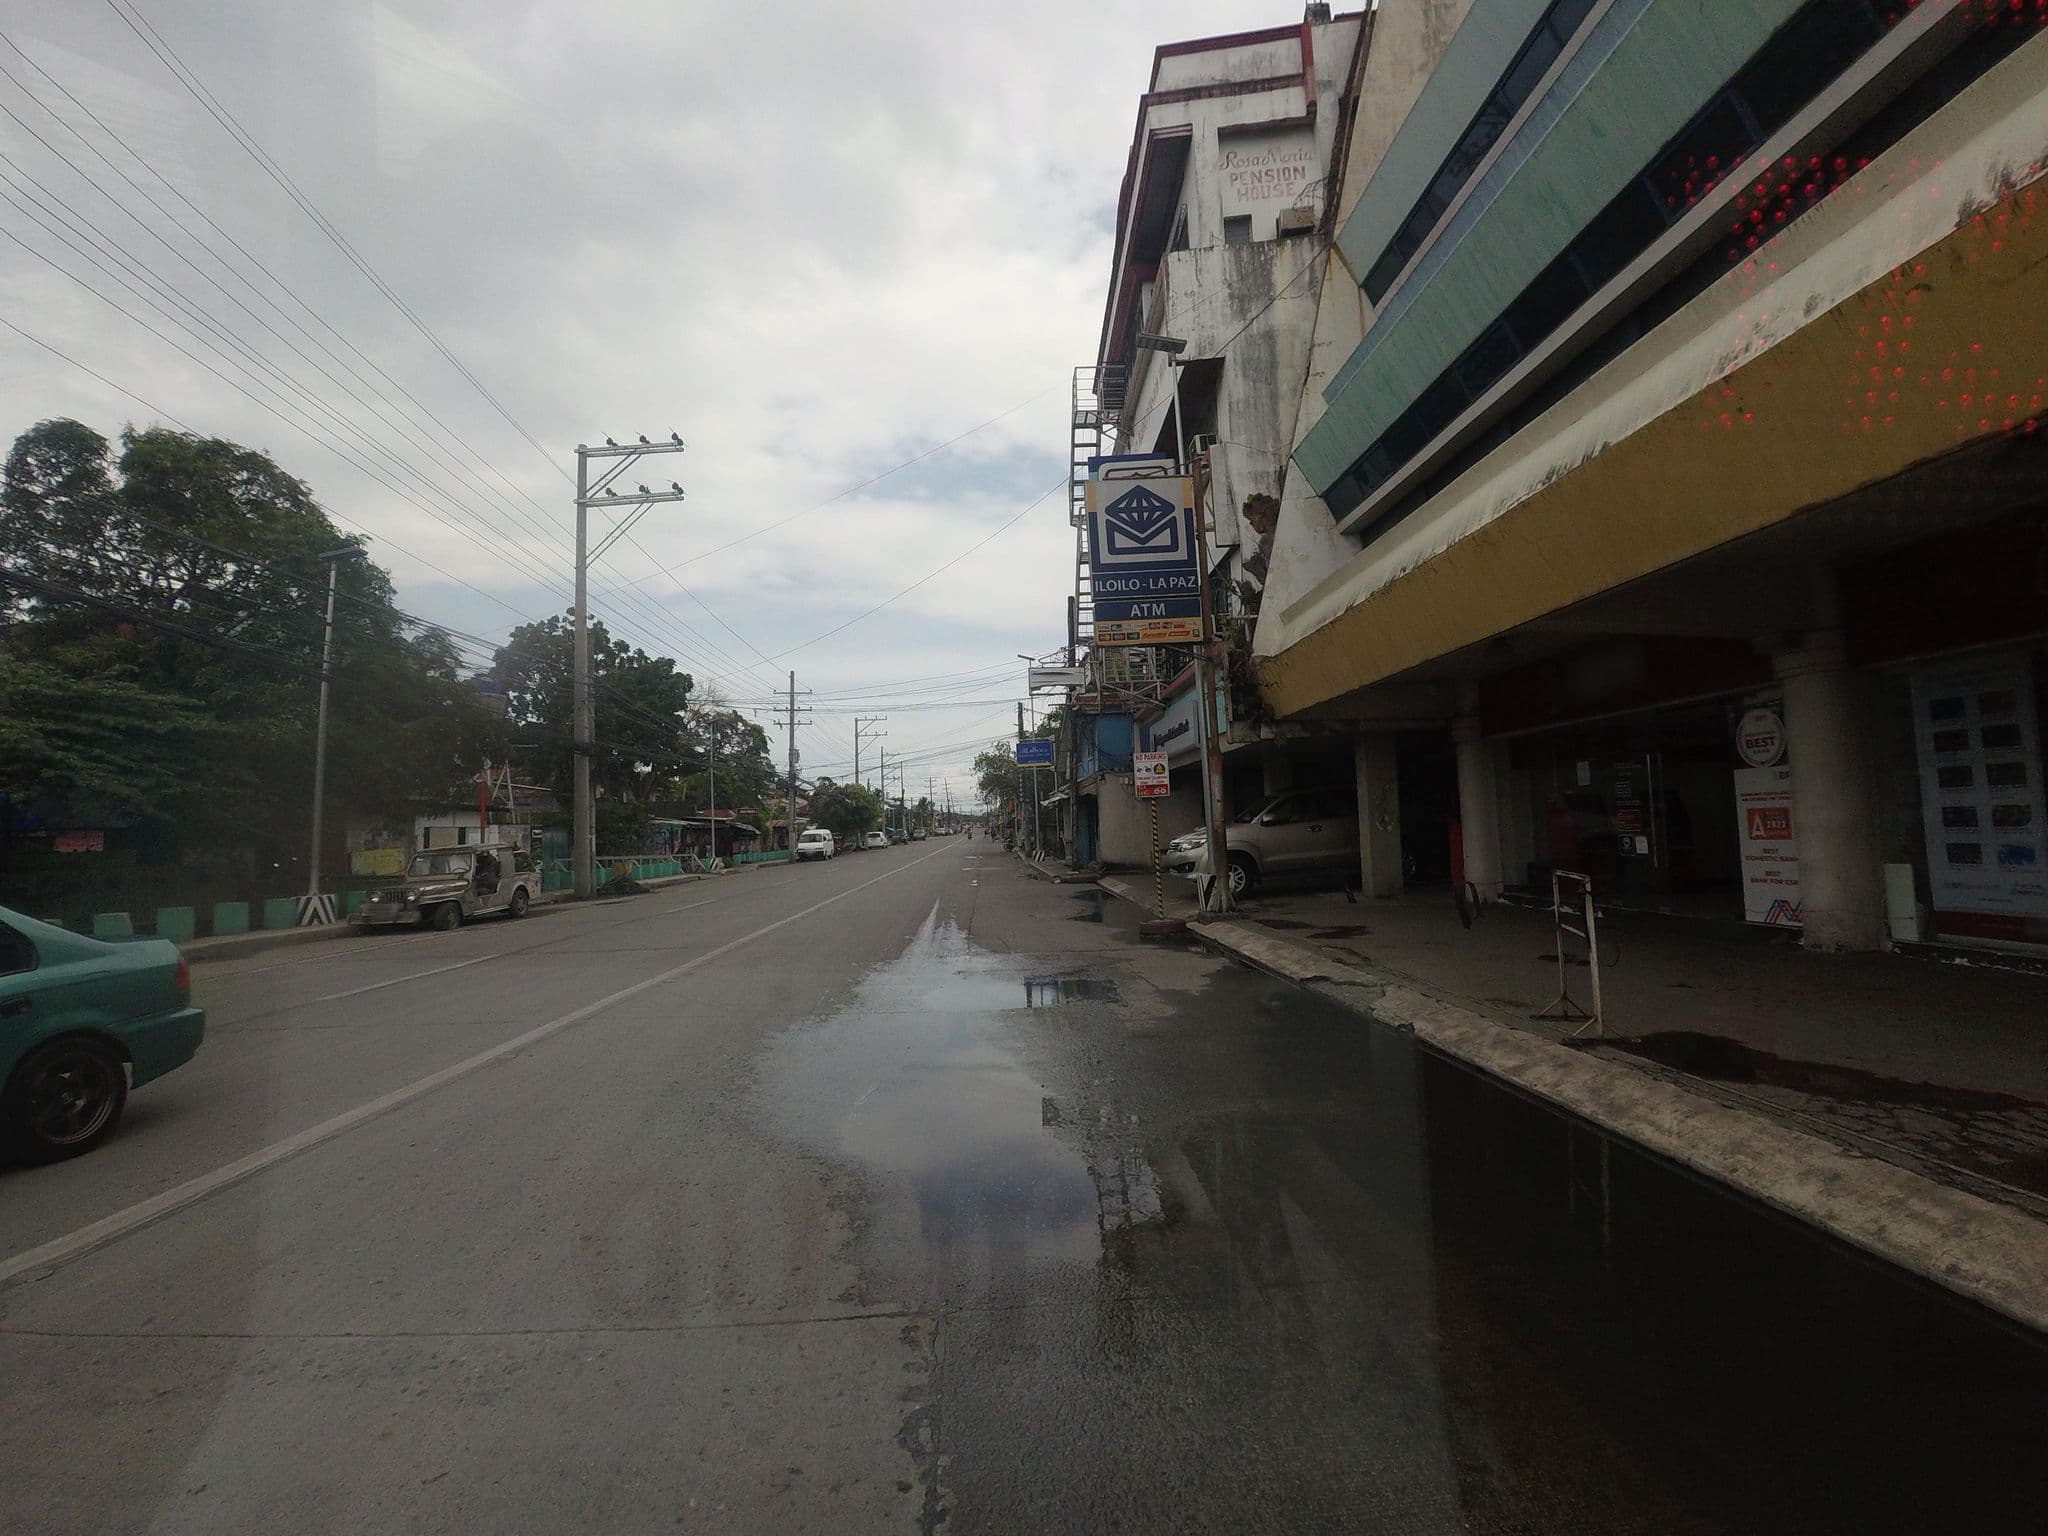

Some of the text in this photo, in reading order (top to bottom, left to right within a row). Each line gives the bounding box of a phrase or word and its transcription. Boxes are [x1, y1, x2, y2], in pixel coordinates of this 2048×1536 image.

[1231, 165, 1306, 187] PENSION
[1237, 181, 1297, 201] HOUSE
[1095, 578, 1140, 592] ILOILO
[1149, 577, 1167, 590] LA
[1169, 576, 1196, 589] PAZ
[1130, 603, 1166, 617] ATM
[1746, 736, 1776, 749] BEST
